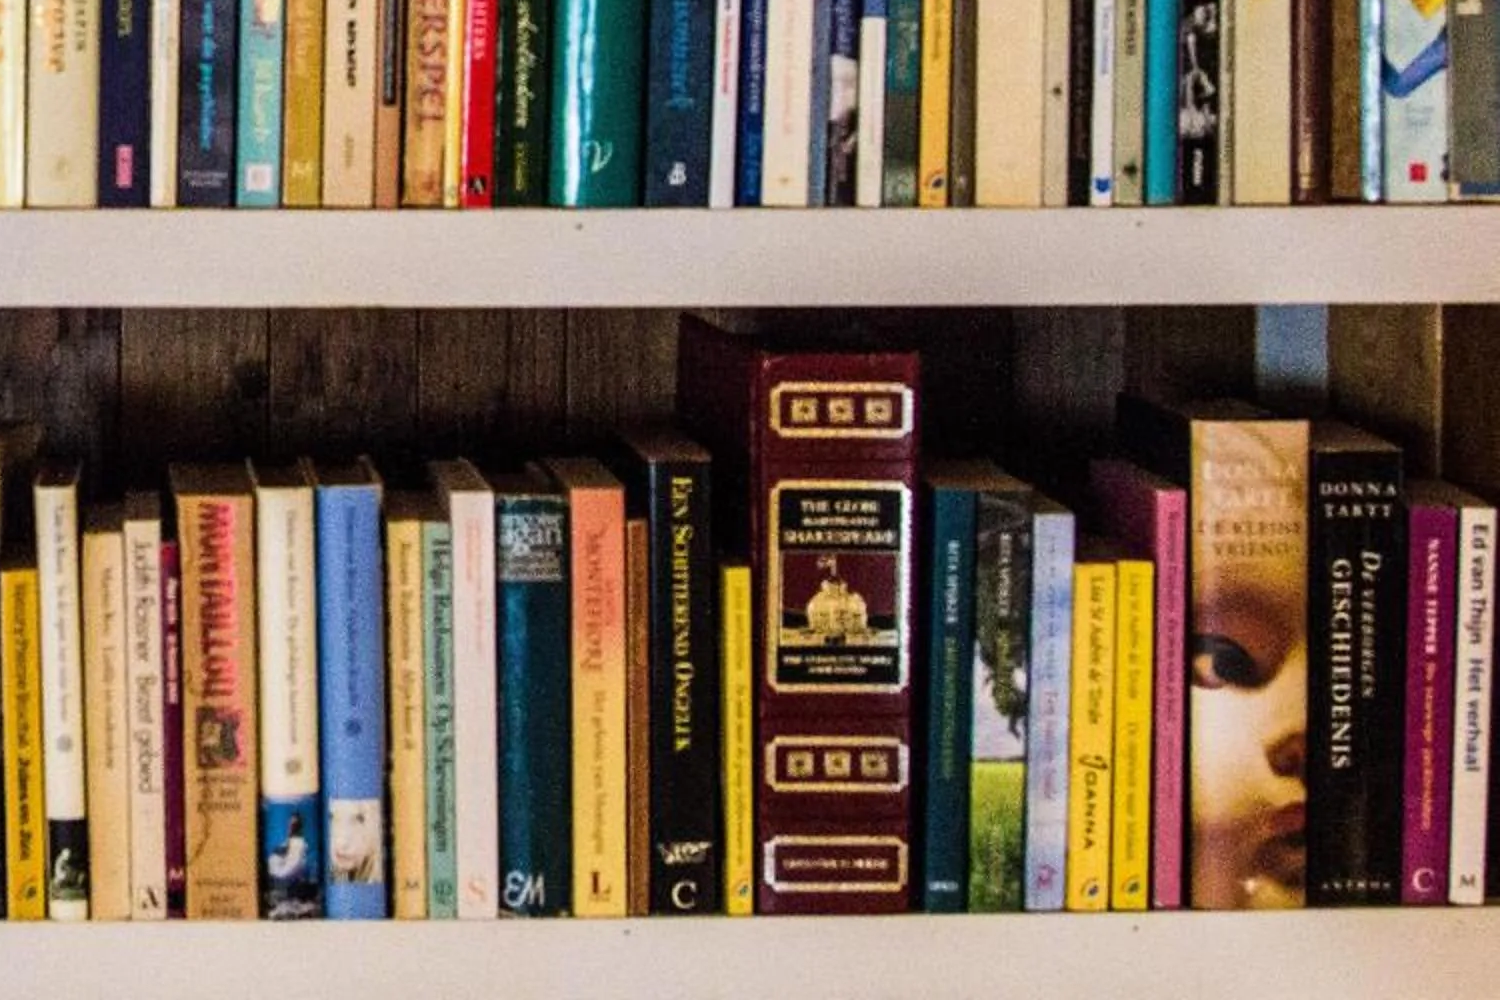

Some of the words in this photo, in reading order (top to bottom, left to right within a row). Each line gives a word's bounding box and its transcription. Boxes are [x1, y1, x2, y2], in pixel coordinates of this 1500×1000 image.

[1319, 482, 1398, 498] DONNA
[1323, 503, 1393, 519] TARTT
[1470, 523, 1489, 552] Ed
[135, 541, 157, 589] Judith
[1470, 557, 1485, 594] van
[197, 504, 239, 701] MONTAILLOU
[1464, 599, 1488, 647] Thijn
[1329, 558, 1353, 771] GESCHIEDENIS
[1467, 658, 1486, 695] Het
[1465, 700, 1485, 775] verhaal
[1080, 754, 1108, 850] JOANNA
